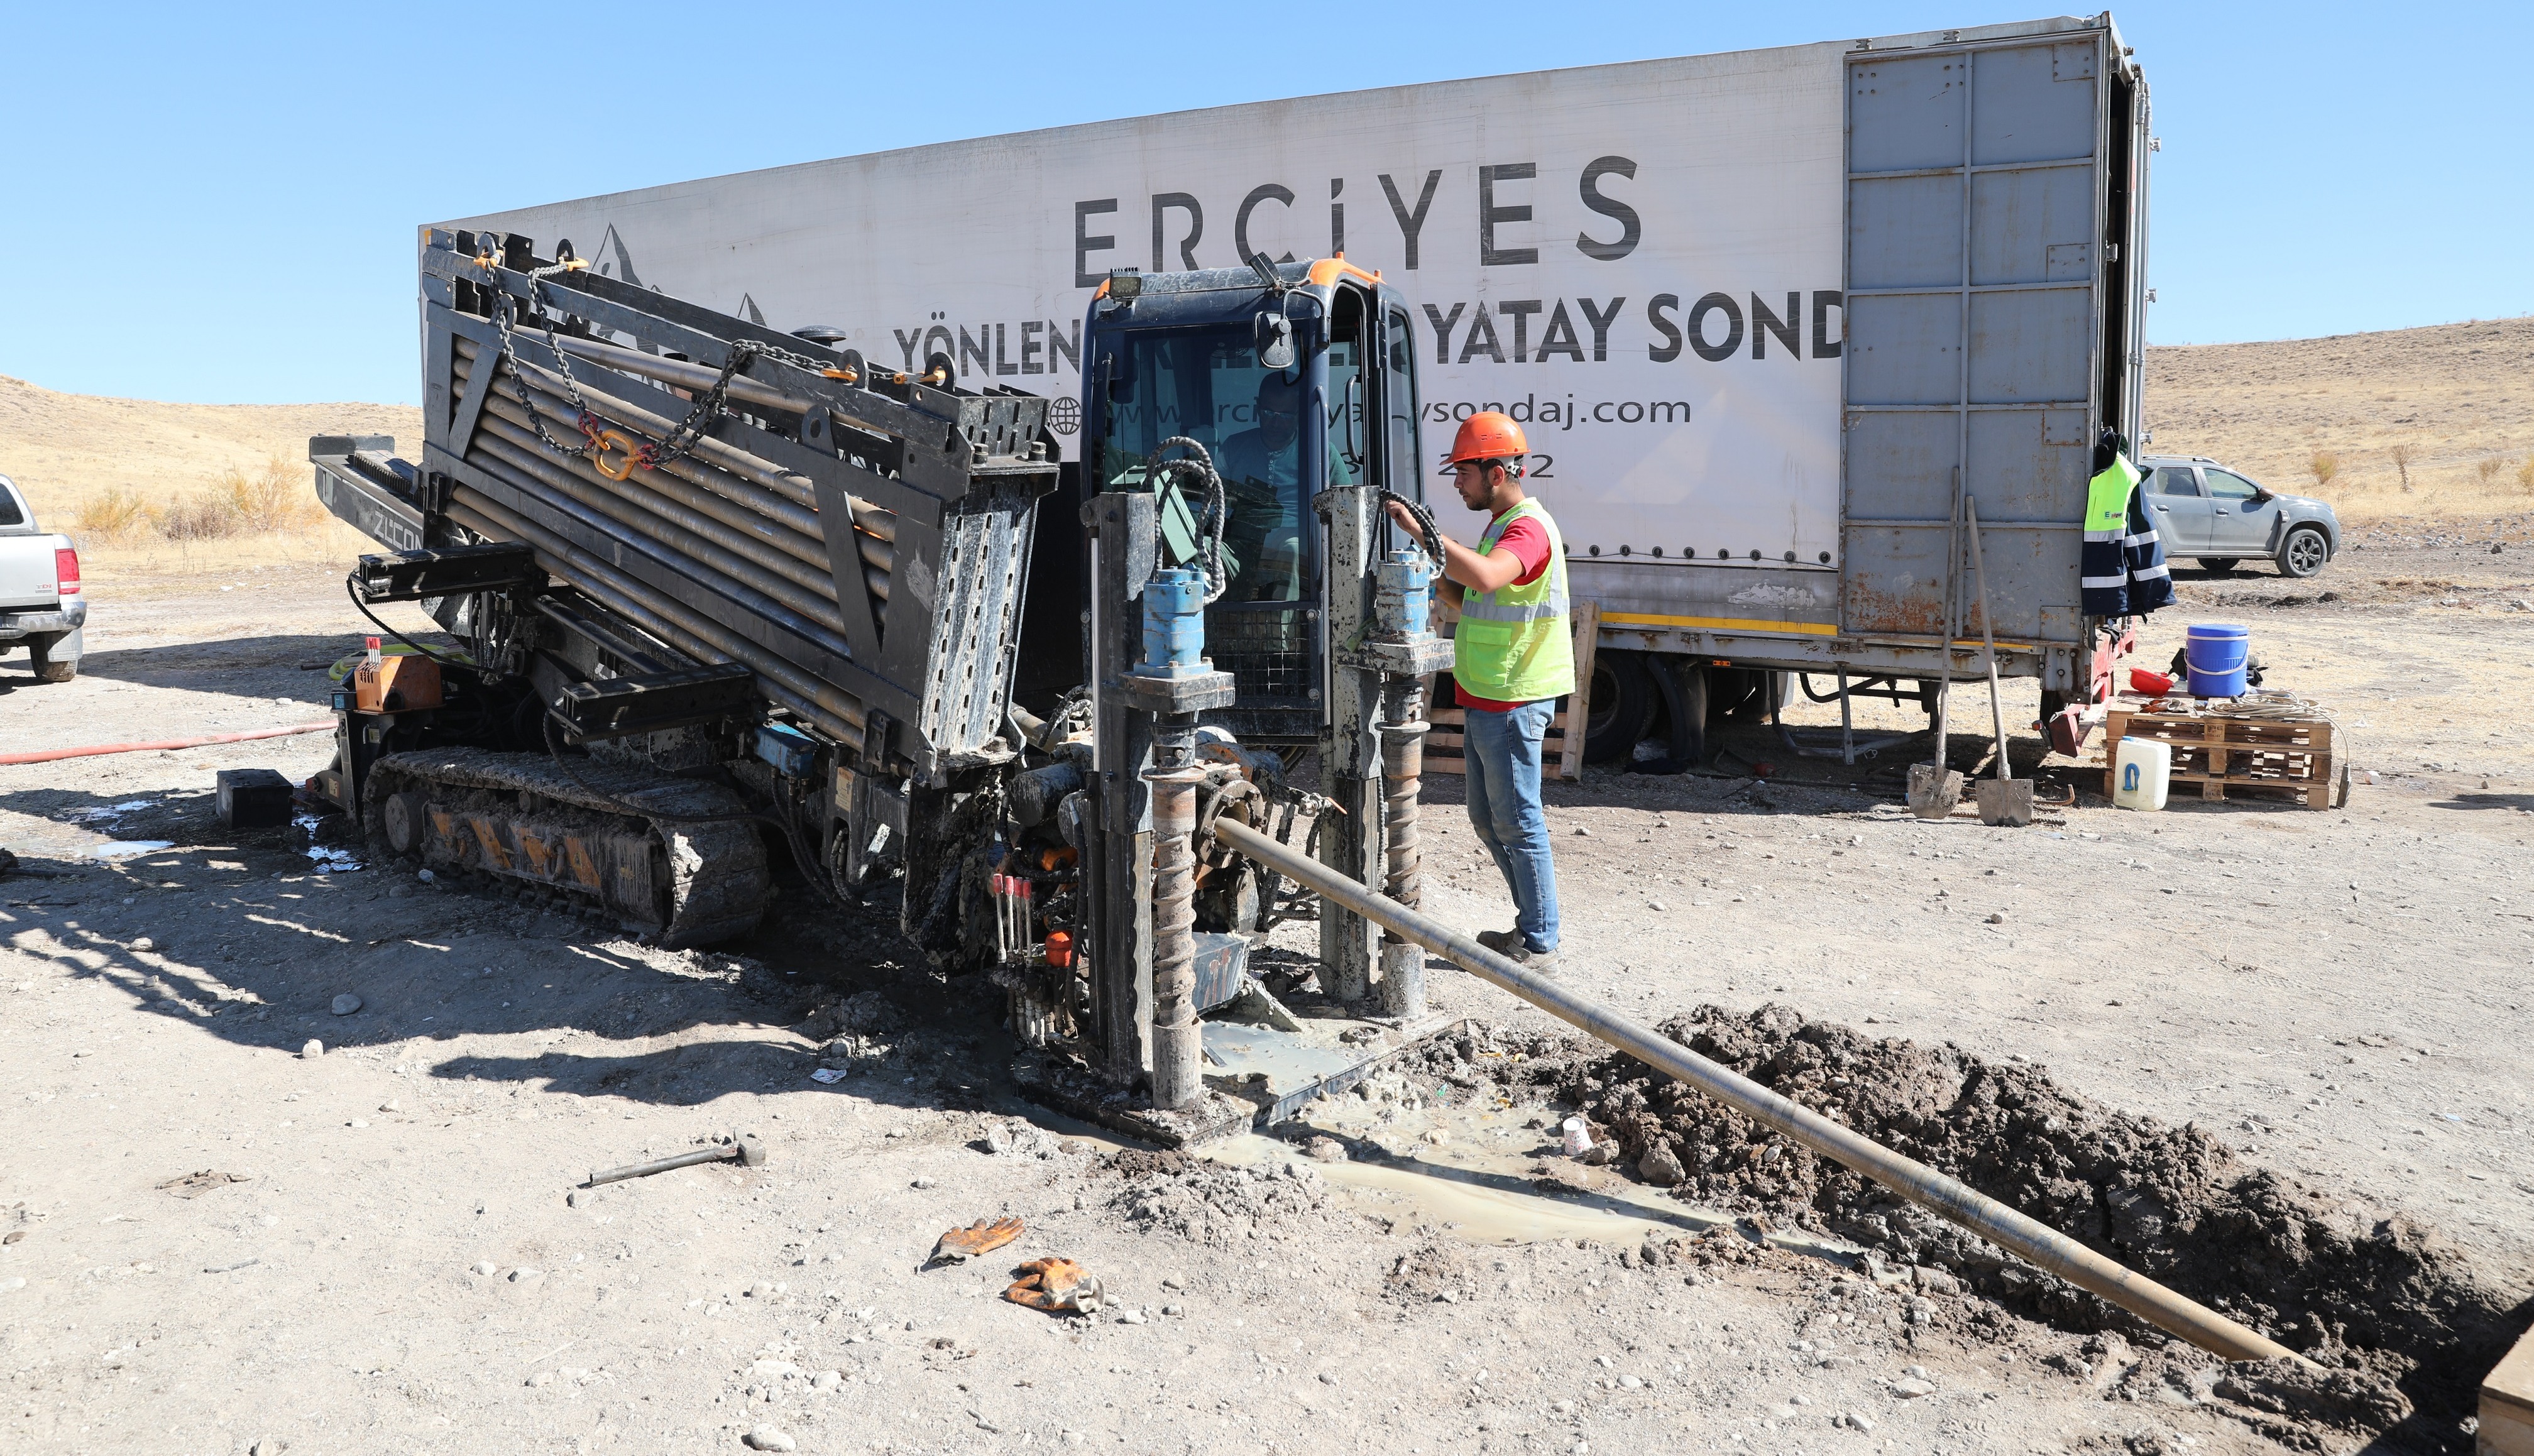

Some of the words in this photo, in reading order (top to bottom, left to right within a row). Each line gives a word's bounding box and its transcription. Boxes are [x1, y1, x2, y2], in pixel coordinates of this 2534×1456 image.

[893, 310, 1080, 377] YÖNLEN
[1422, 297, 1626, 364] YATAY
[1648, 290, 1842, 363] SOND
